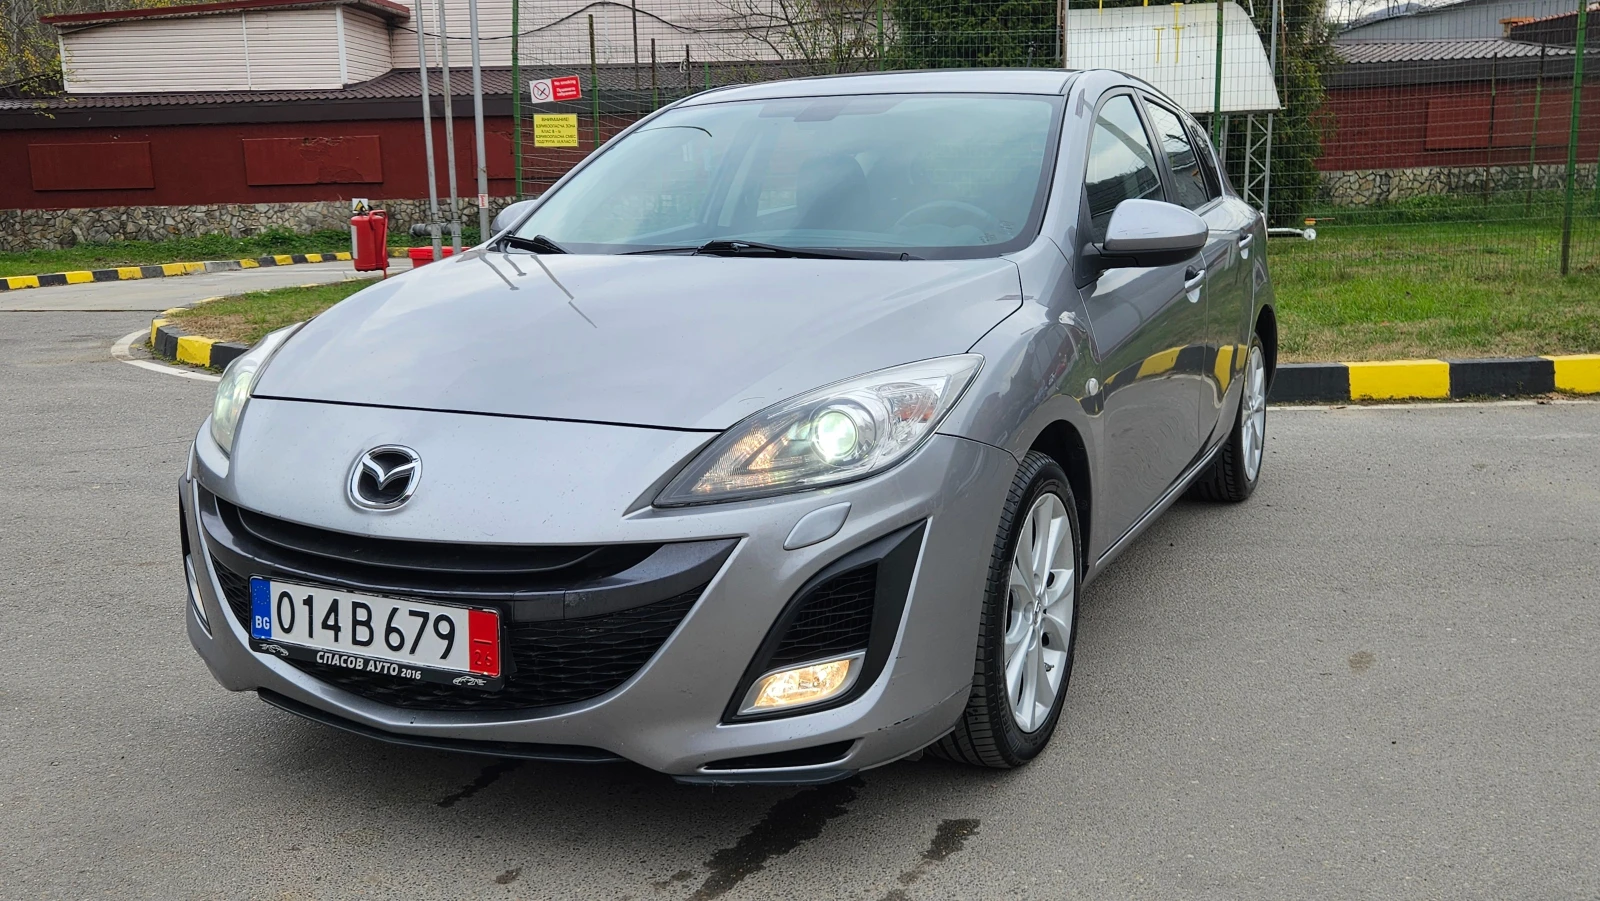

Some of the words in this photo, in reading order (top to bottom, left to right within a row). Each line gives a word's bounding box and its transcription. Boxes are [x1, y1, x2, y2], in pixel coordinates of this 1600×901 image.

[255, 615, 270, 630] BG
[316, 651, 364, 670] СПАСОВ
[366, 660, 399, 676] АУТО
[400, 668, 422, 680] 2016
